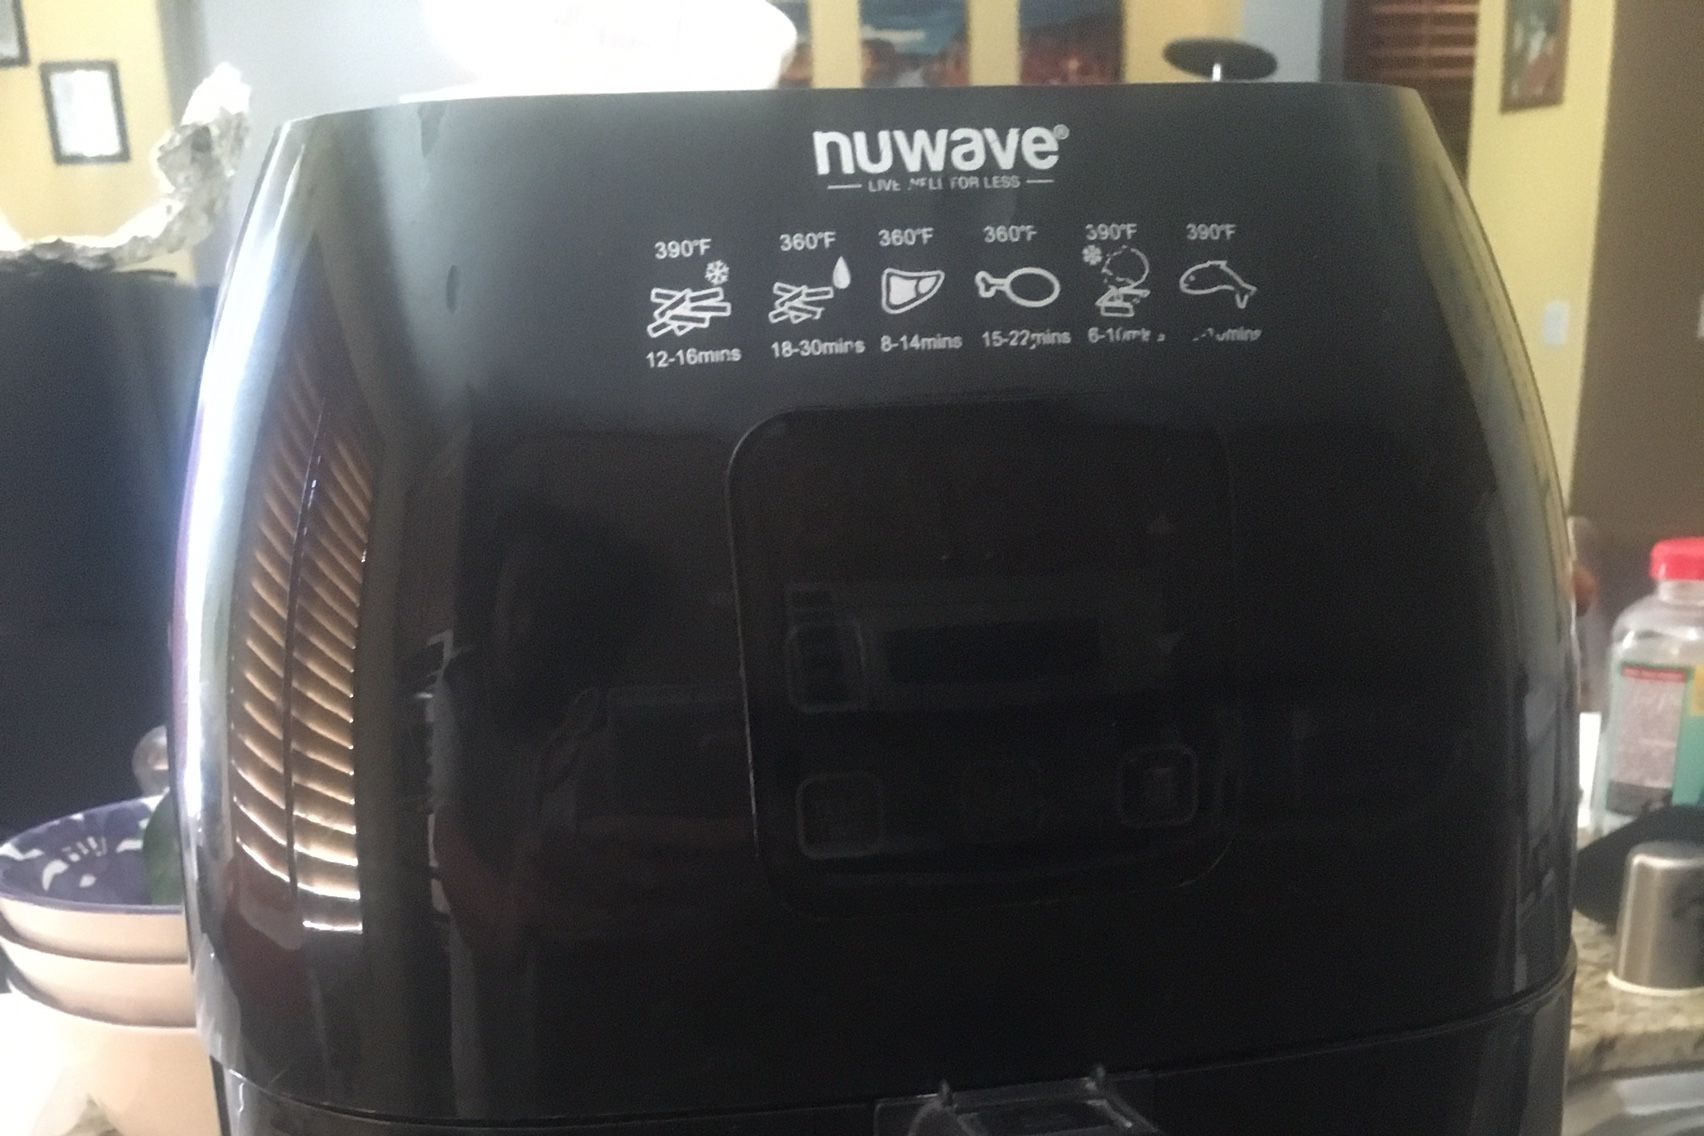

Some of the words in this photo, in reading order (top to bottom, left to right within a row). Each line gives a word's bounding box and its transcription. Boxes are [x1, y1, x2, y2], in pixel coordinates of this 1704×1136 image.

[984, 175, 1020, 188] LESS
[771, 338, 866, 358] 18-30mins
[880, 333, 963, 352] 8-14mins
[646, 347, 742, 368] 12-16mins
